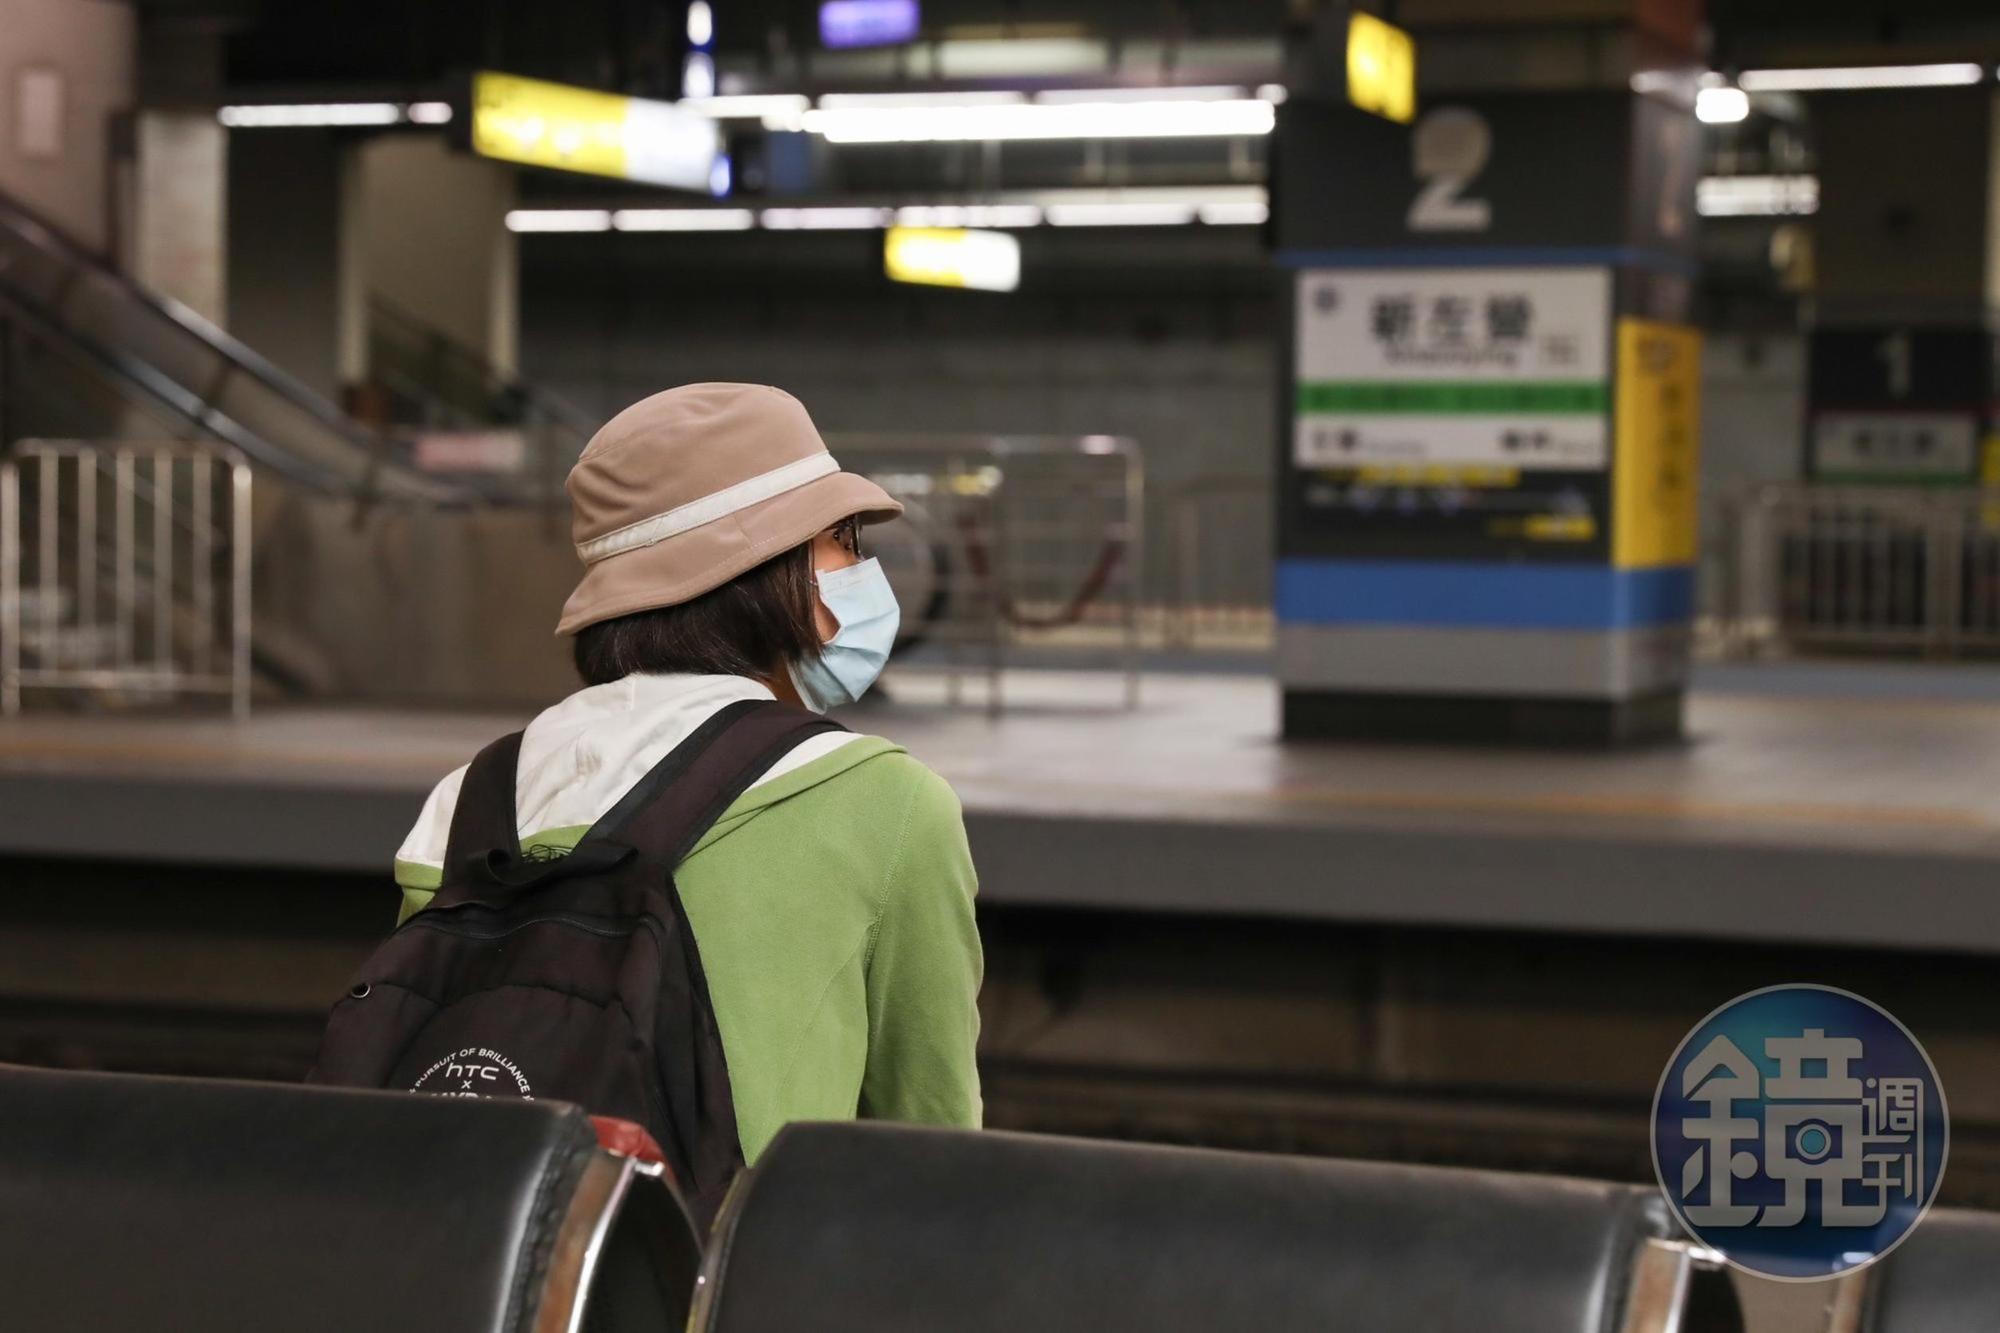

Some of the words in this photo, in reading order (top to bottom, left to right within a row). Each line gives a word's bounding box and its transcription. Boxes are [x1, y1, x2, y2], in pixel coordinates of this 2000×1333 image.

[1408, 106, 1490, 232] 2
[415, 1052, 456, 1087] PURSUIT
[459, 1047, 477, 1058] OF
[478, 1048, 531, 1093] BRILLIANCE
